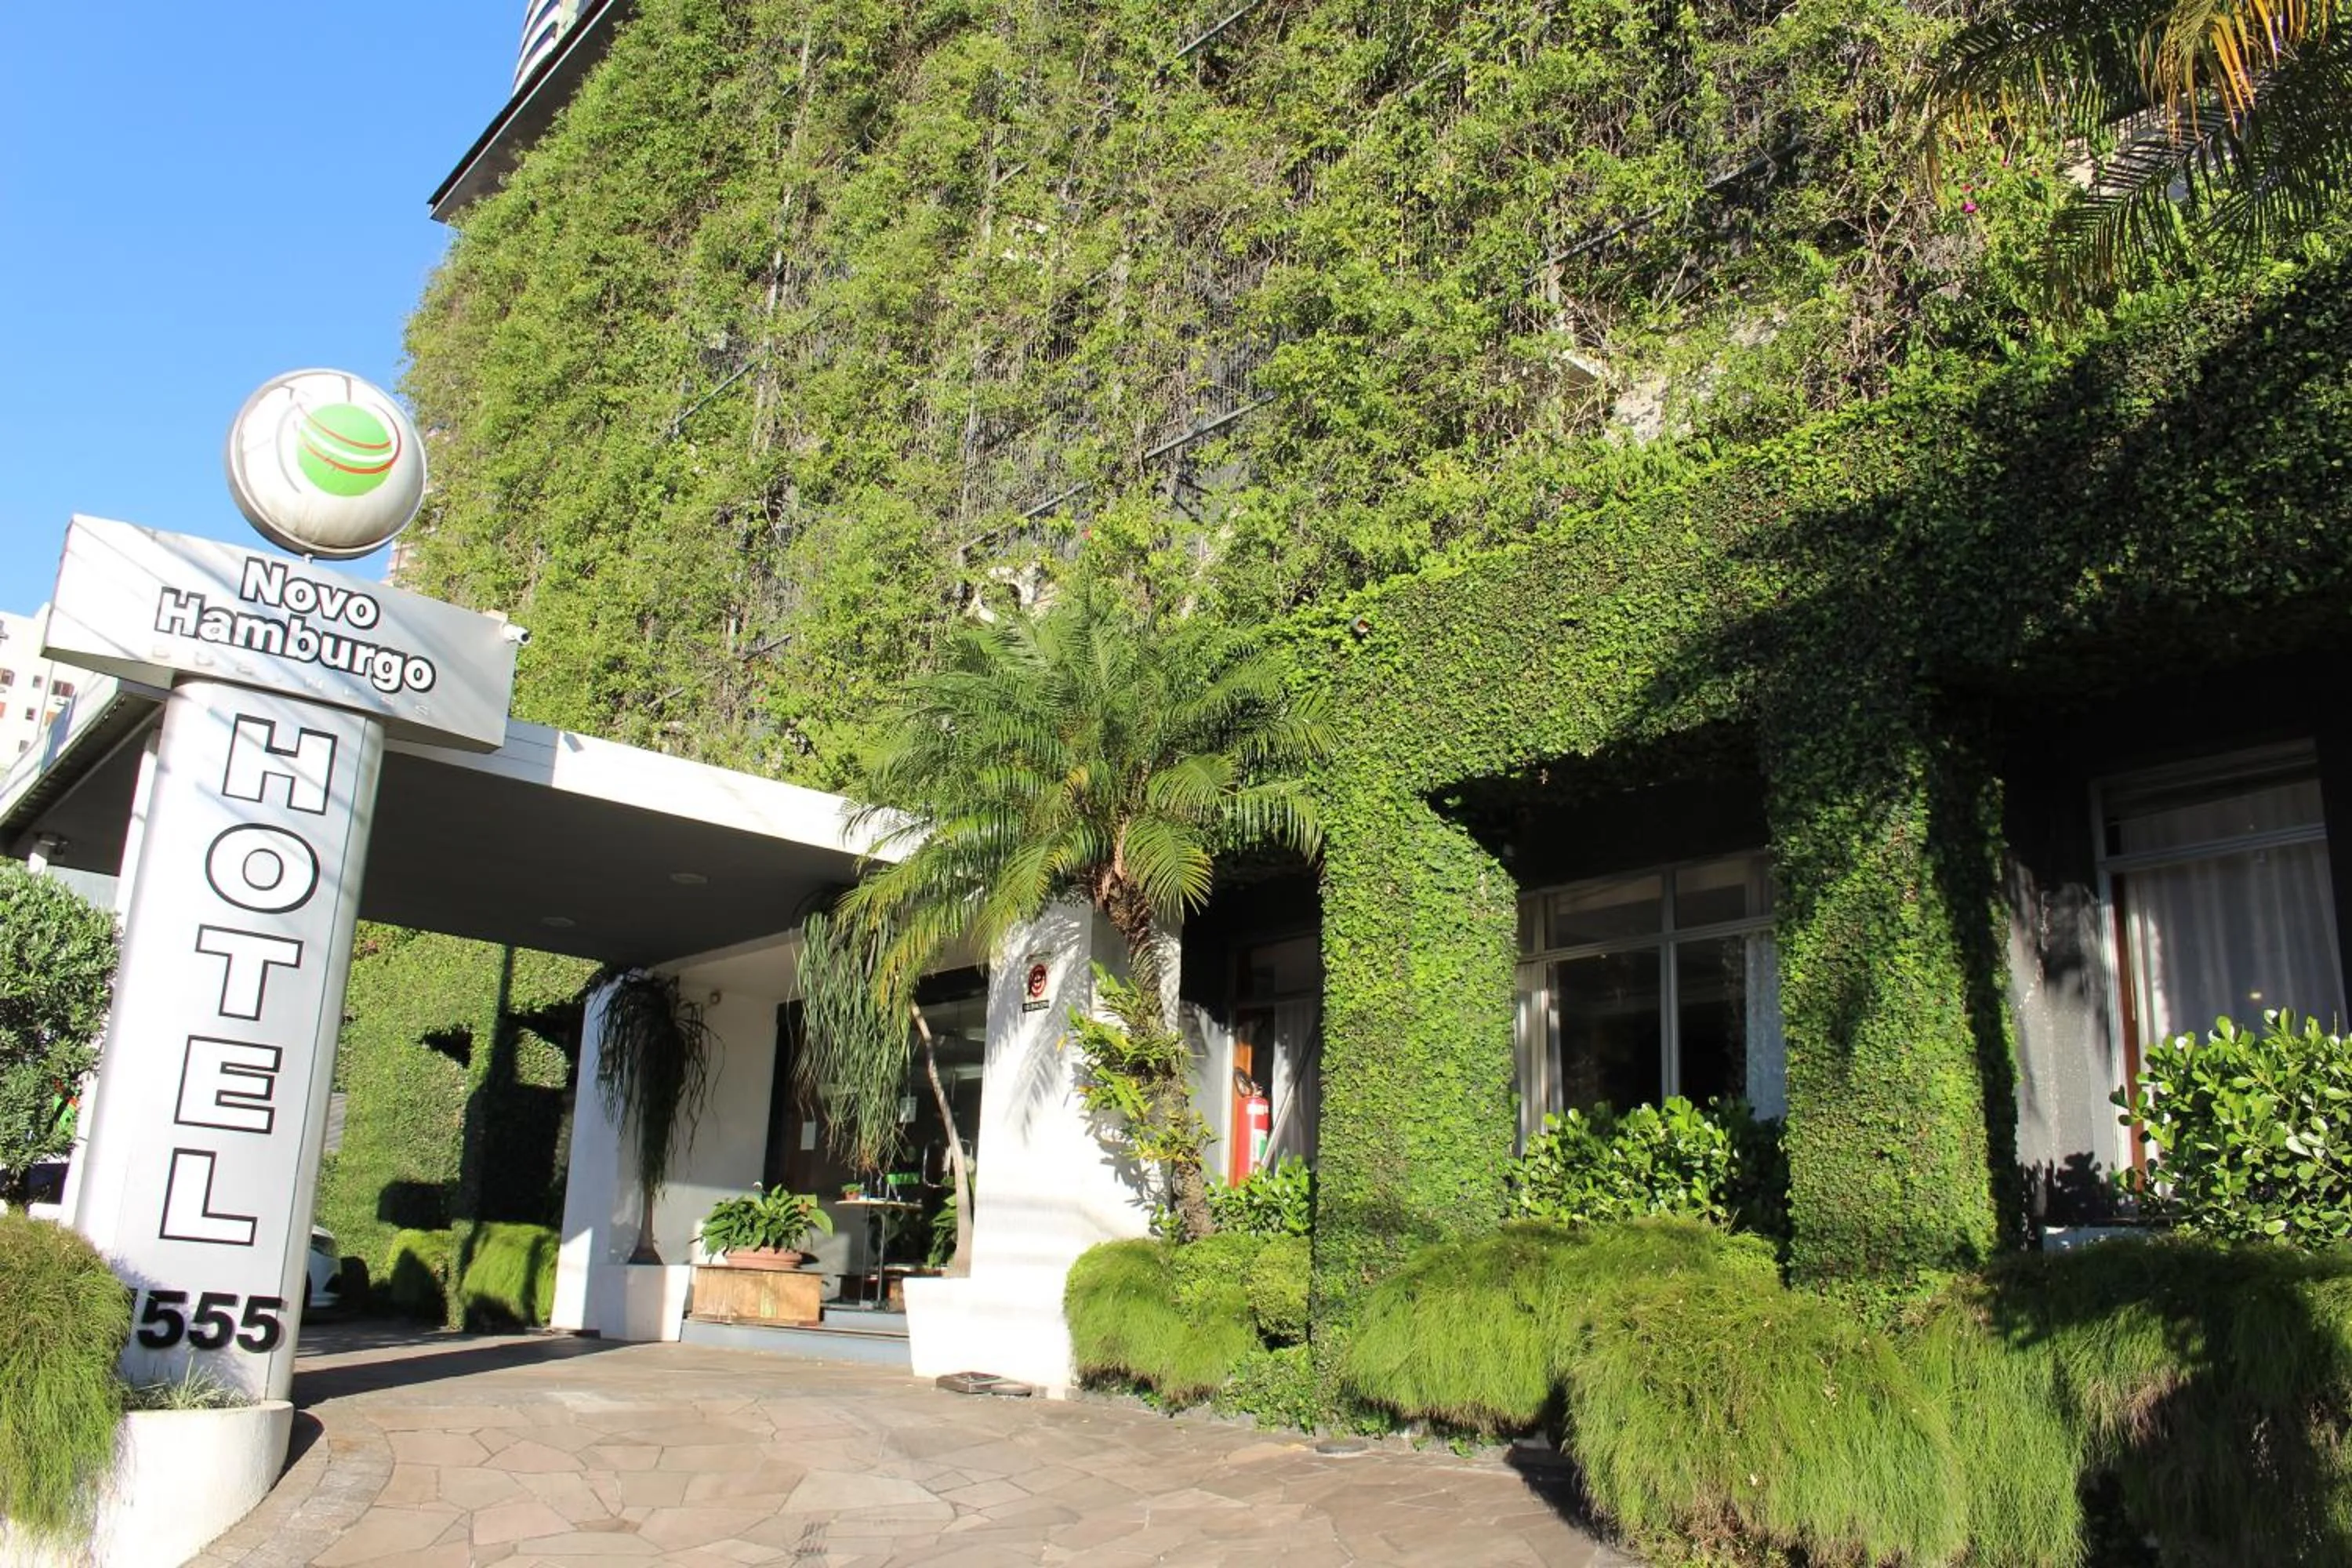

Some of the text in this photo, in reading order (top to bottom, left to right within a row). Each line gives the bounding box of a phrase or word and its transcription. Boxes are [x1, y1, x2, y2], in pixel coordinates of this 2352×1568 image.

[239, 556, 380, 629] Novo
[154, 586, 437, 694] Hamburgo
[158, 713, 339, 1247] HOTEL
[129, 1288, 283, 1354] 555
